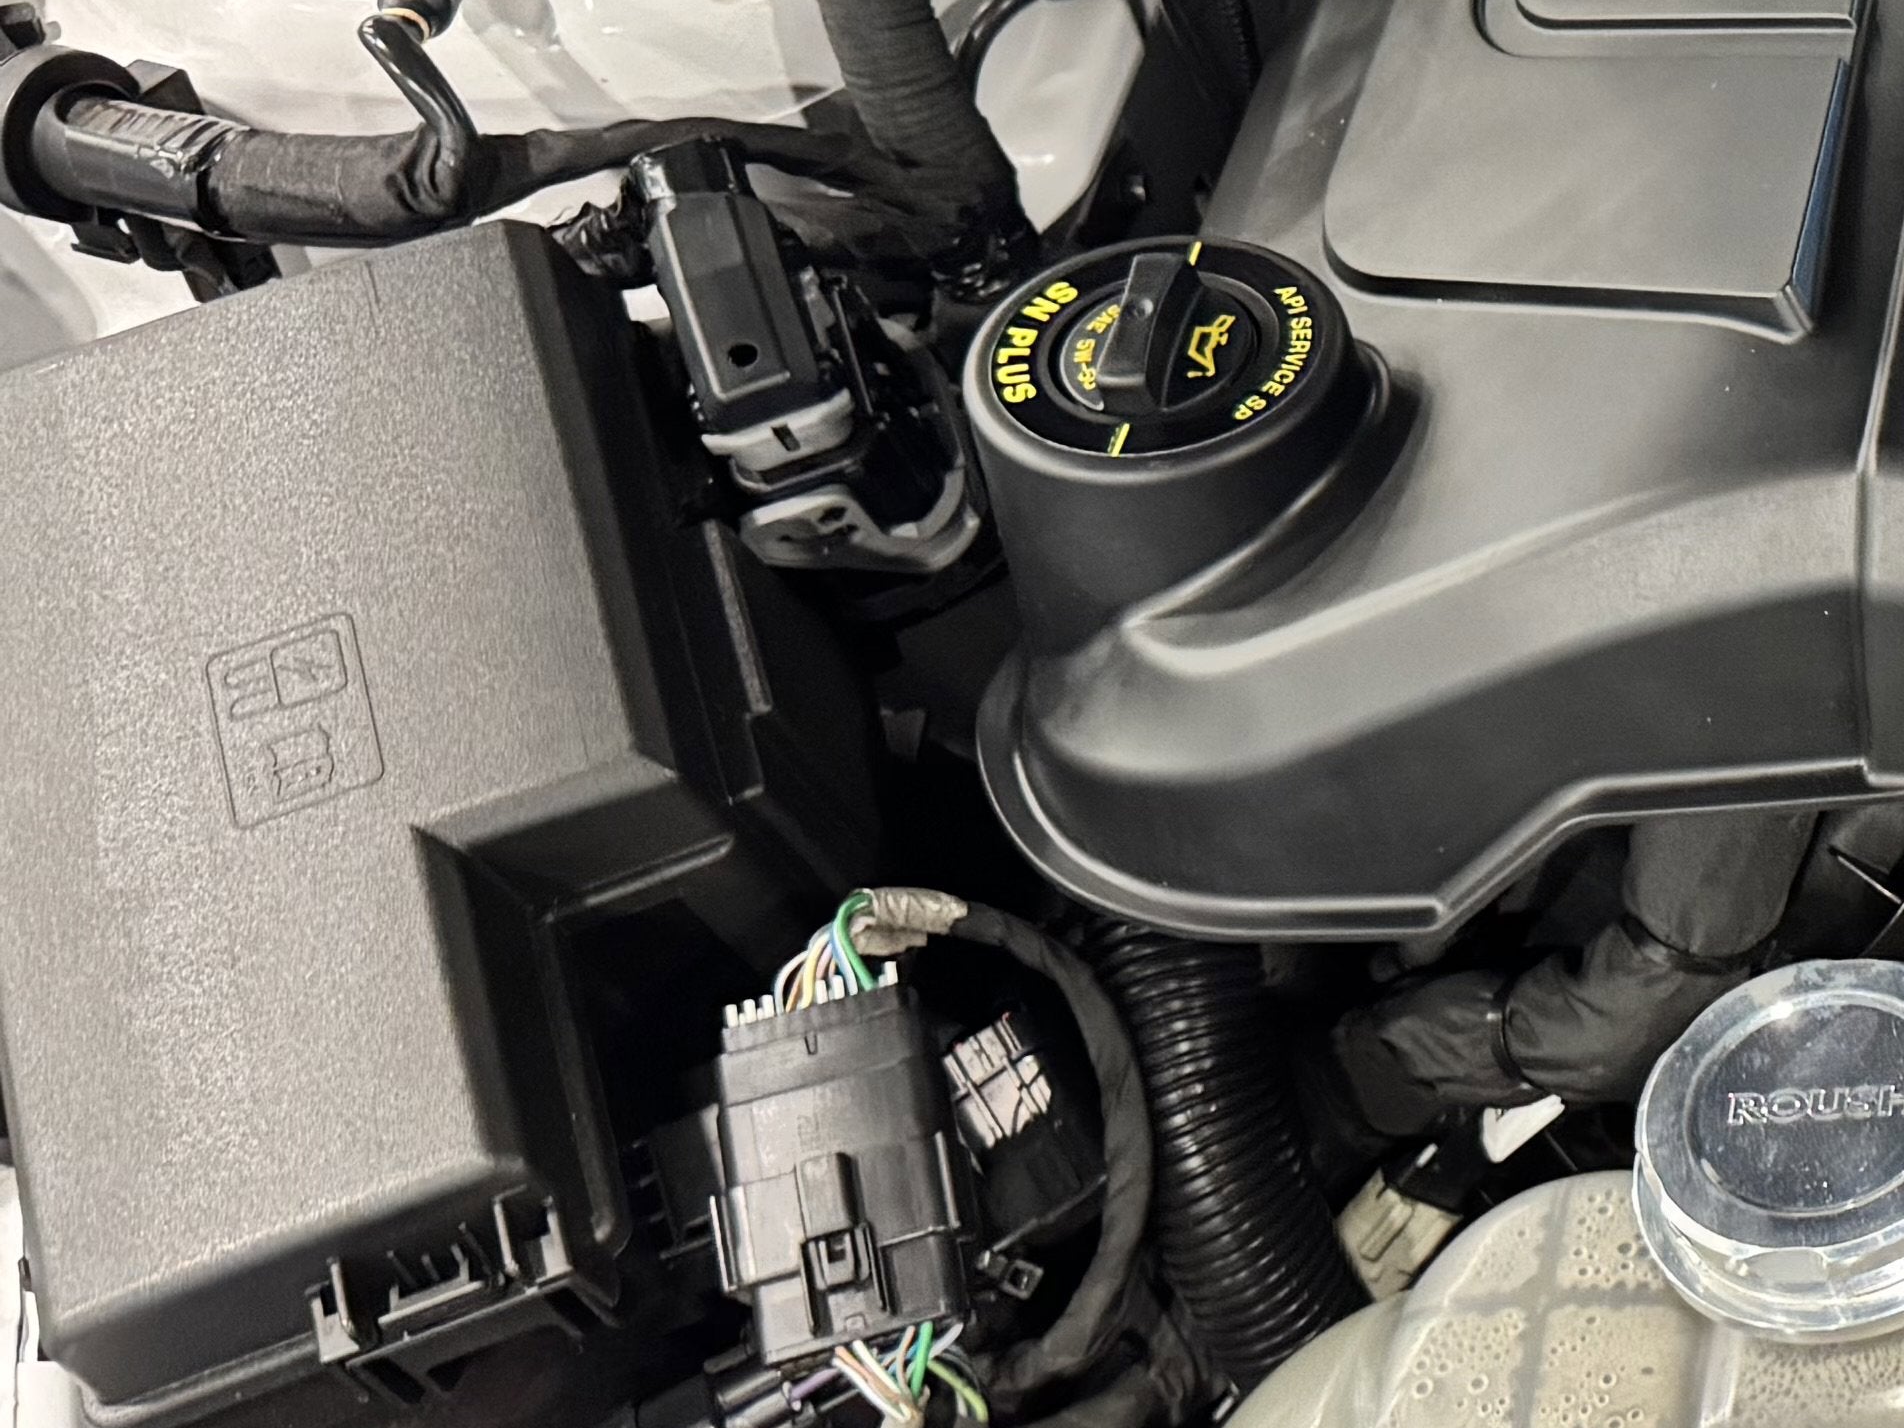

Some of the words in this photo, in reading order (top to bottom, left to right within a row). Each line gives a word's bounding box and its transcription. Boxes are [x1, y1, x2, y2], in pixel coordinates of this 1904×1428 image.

[1022, 281, 1079, 322] SN
[1273, 286, 1309, 315] API
[1086, 304, 1120, 334] SAE
[996, 326, 1038, 403] PLUS
[1260, 316, 1313, 397] SERVICE
[1233, 395, 1268, 421] SP
